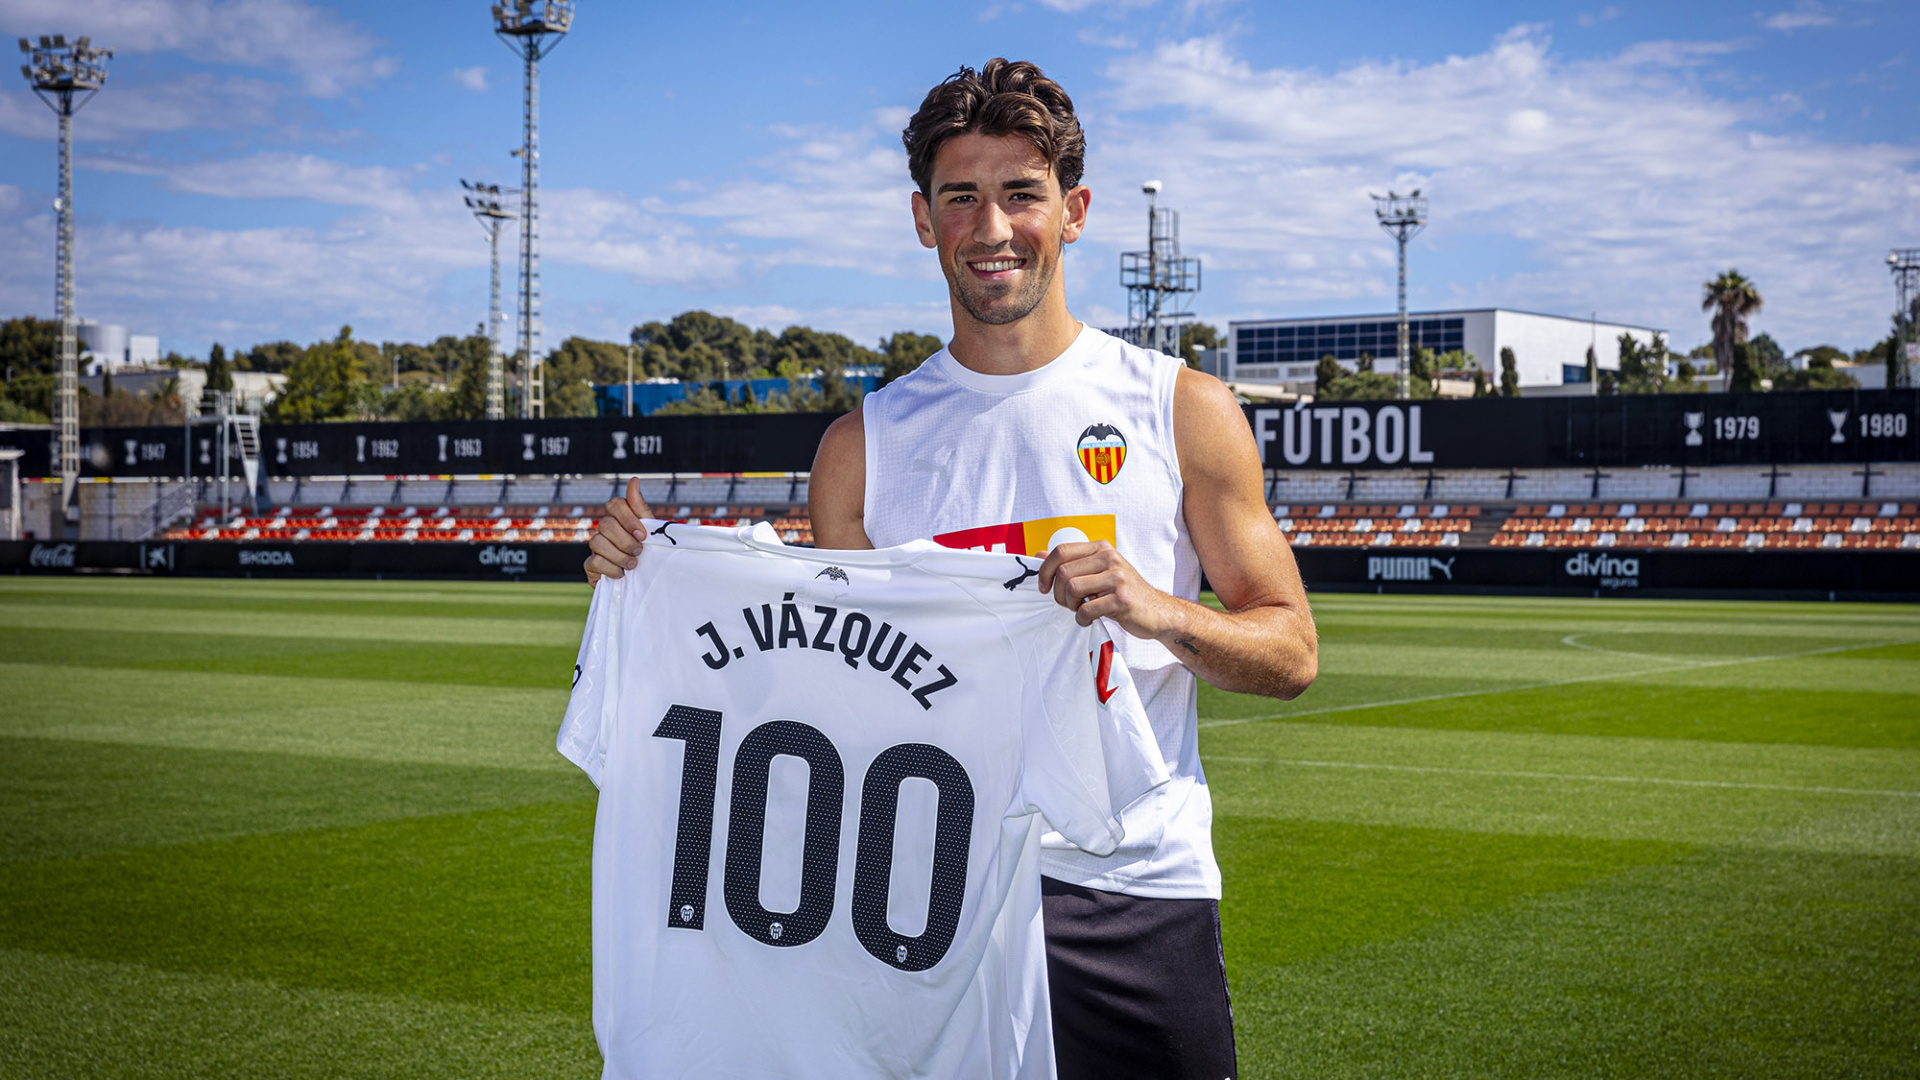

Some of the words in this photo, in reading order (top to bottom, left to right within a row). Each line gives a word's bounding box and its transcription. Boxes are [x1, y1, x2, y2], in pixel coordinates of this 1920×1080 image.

[1254, 401, 1434, 464] FÚTBOL
[1713, 416, 1760, 440] 1979
[1859, 413, 1908, 438] 1980
[371, 439, 399, 458] 1962
[453, 438, 482, 457] 1963
[540, 436, 570, 456] 1967
[633, 435, 663, 455] 1971
[479, 545, 528, 565] divina
[1565, 552, 1640, 576] divina
[1368, 556, 1432, 581] PUMA
[695, 621, 745, 670] J.
[742, 592, 958, 711] VÁZQUEZ
[651, 704, 976, 972] 100
